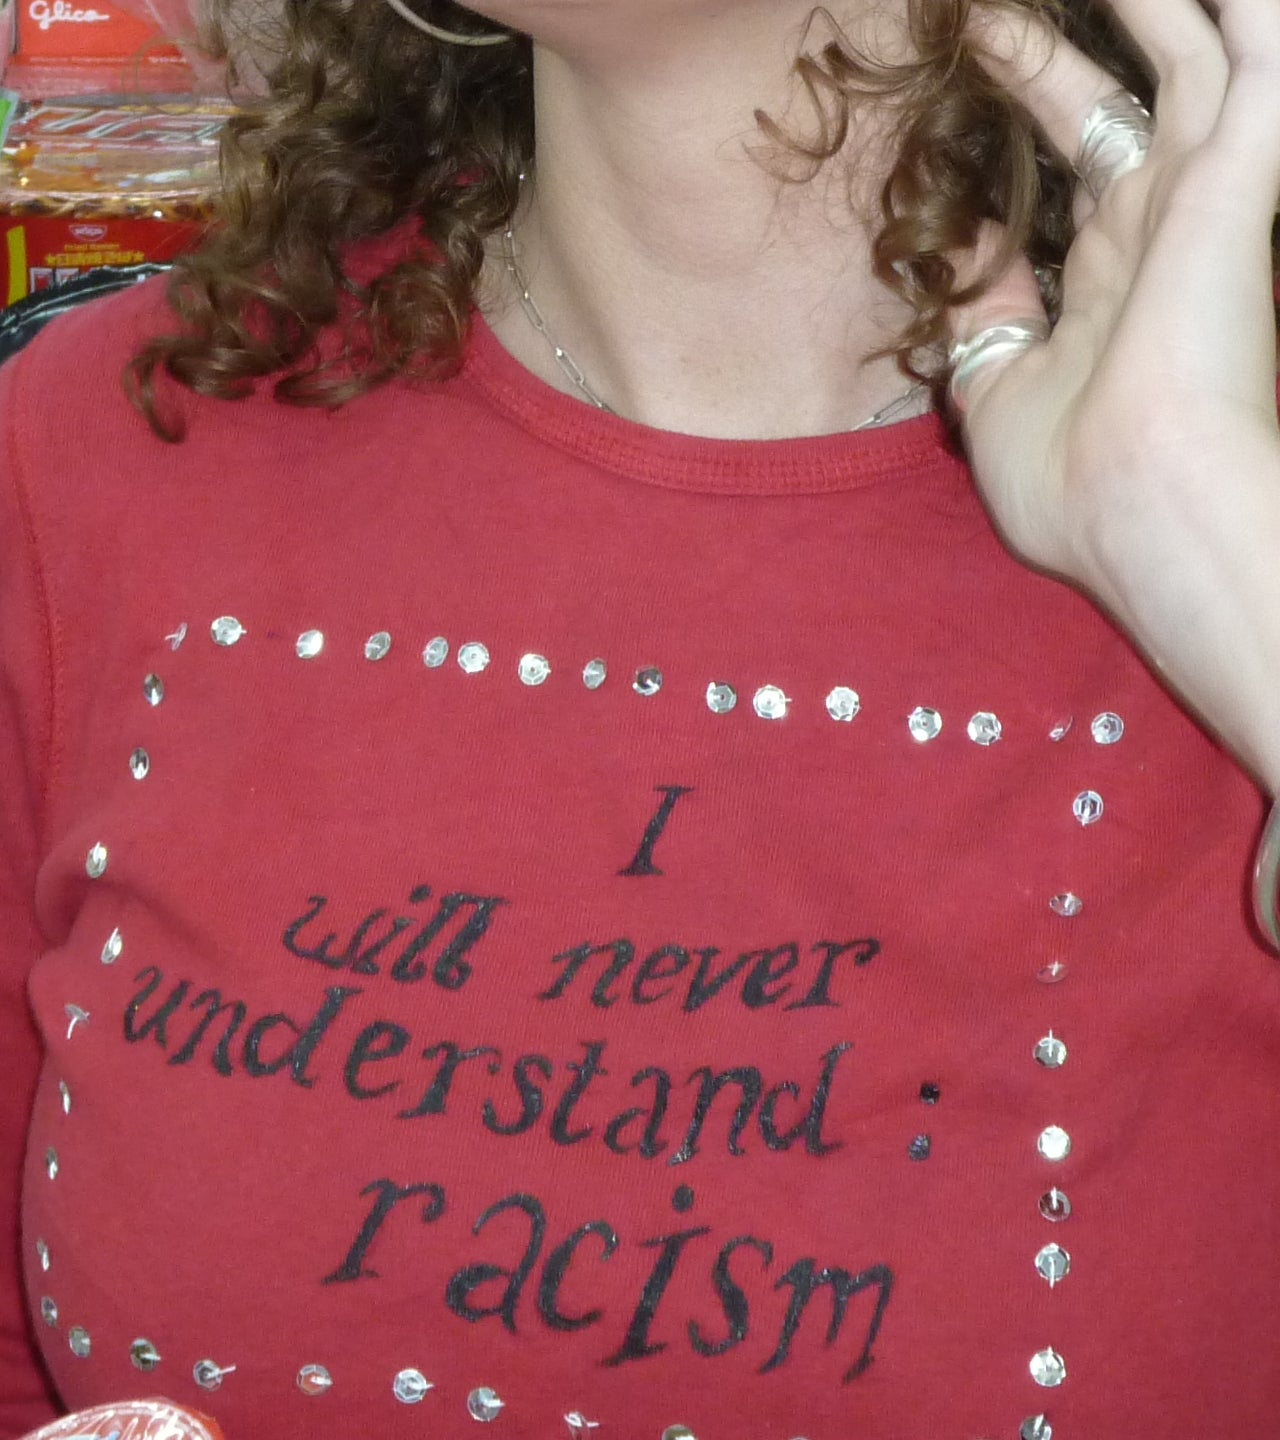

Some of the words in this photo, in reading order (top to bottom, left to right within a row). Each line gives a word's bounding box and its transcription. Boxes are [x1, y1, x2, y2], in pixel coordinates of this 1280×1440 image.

[29, 0, 110, 30] Glico
[616, 784, 697, 877] I
[281, 882, 511, 991] will
[537, 936, 882, 1013] never
[122, 965, 855, 1167] understand
[320, 1177, 895, 1385] racism
